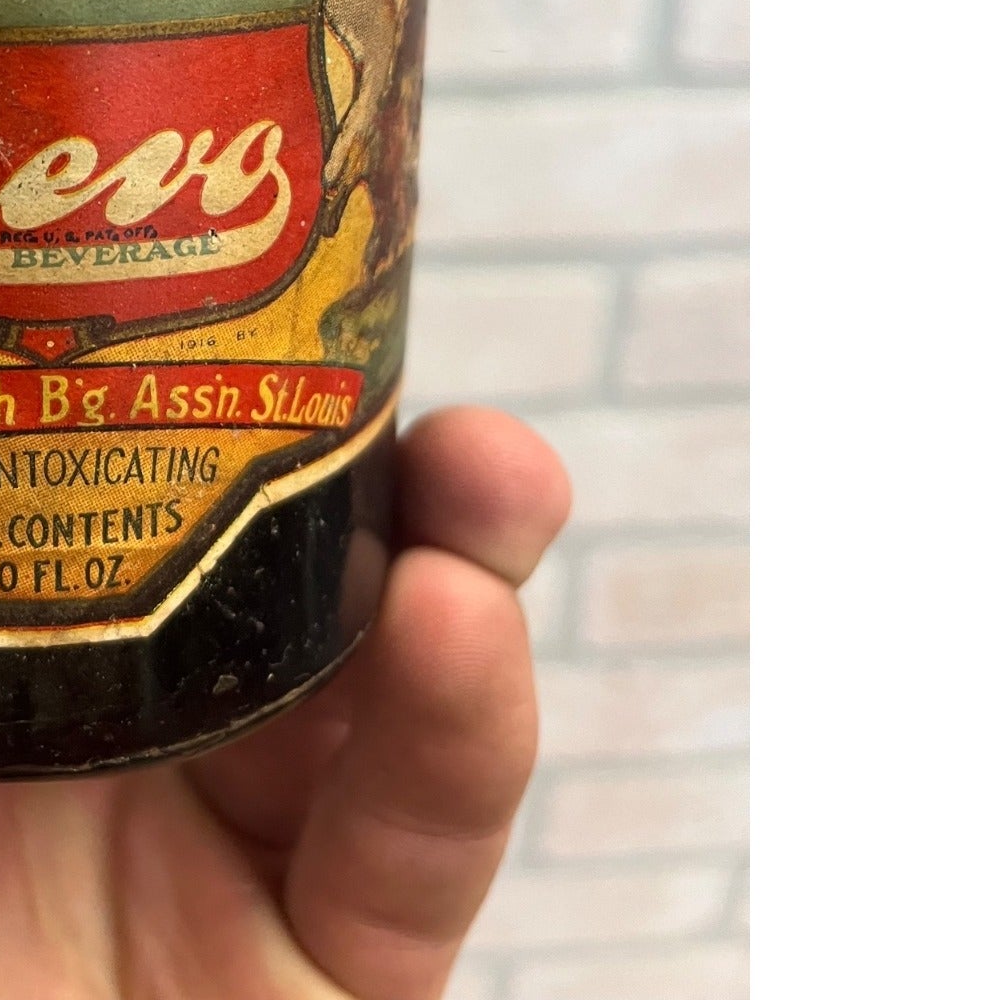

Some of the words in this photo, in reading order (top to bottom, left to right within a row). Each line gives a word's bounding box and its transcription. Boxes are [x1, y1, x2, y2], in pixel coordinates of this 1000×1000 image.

[11, 233, 221, 268] BEVERAGE
[180, 335, 216, 350] 1916
[236, 327, 257, 341] BY
